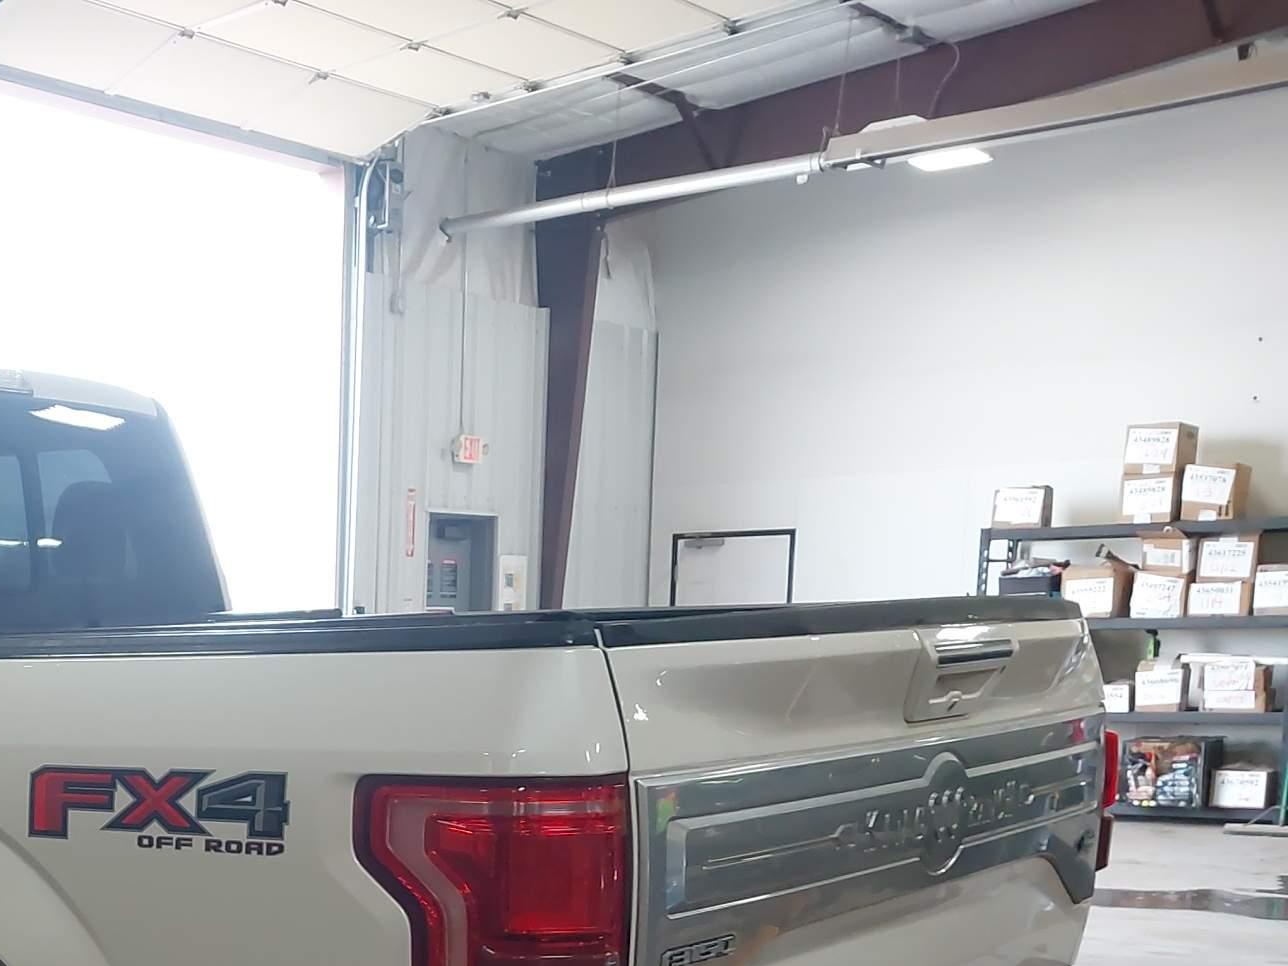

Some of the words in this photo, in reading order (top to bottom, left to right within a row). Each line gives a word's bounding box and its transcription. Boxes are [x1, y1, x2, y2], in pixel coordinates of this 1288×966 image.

[28, 764, 290, 840] FX4
[137, 835, 193, 850] OFF
[204, 838, 286, 857] ROAD
